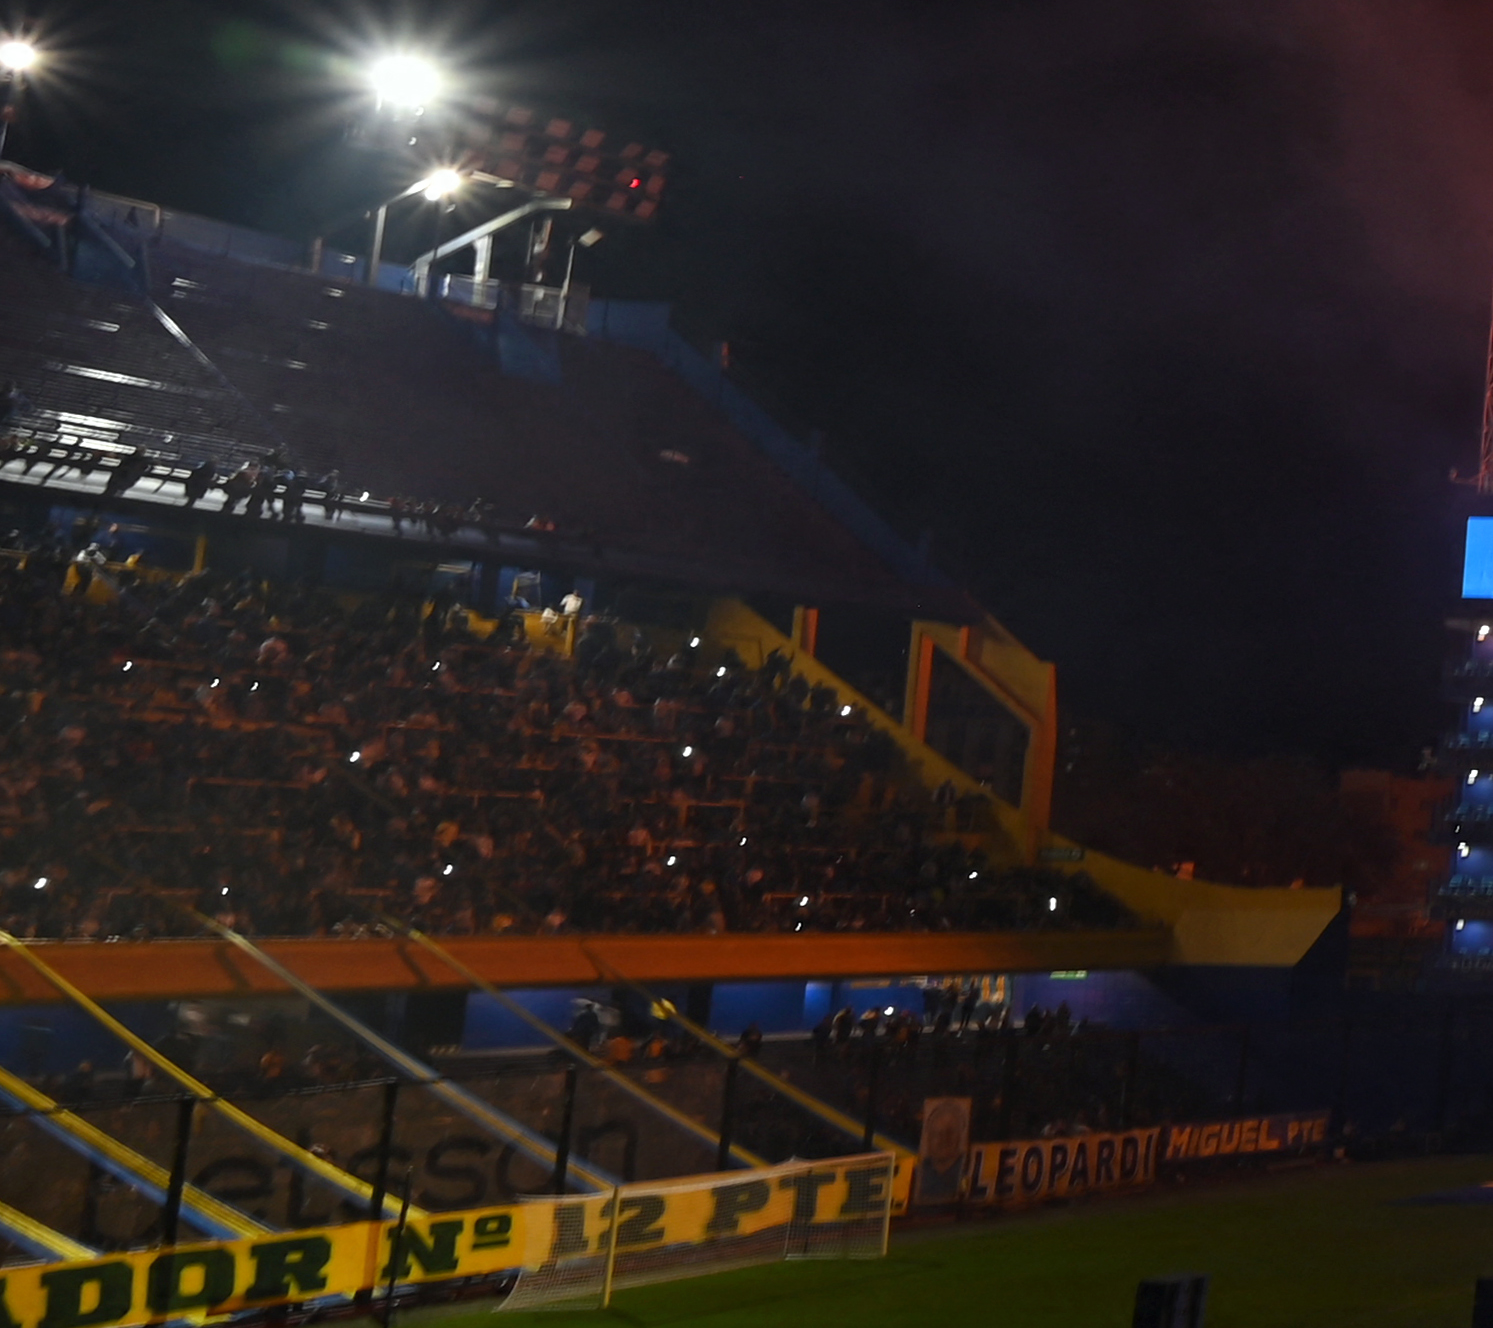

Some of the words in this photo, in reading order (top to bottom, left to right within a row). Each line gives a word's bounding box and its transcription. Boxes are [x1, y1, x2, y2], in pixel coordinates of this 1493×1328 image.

[969, 1126, 1162, 1203] LEOPARDI
[1166, 1119, 1281, 1161] MIGUEL
[1286, 1118, 1328, 1145] PTE
[551, 1194, 667, 1260] 12
[704, 1165, 890, 1240] PTE
